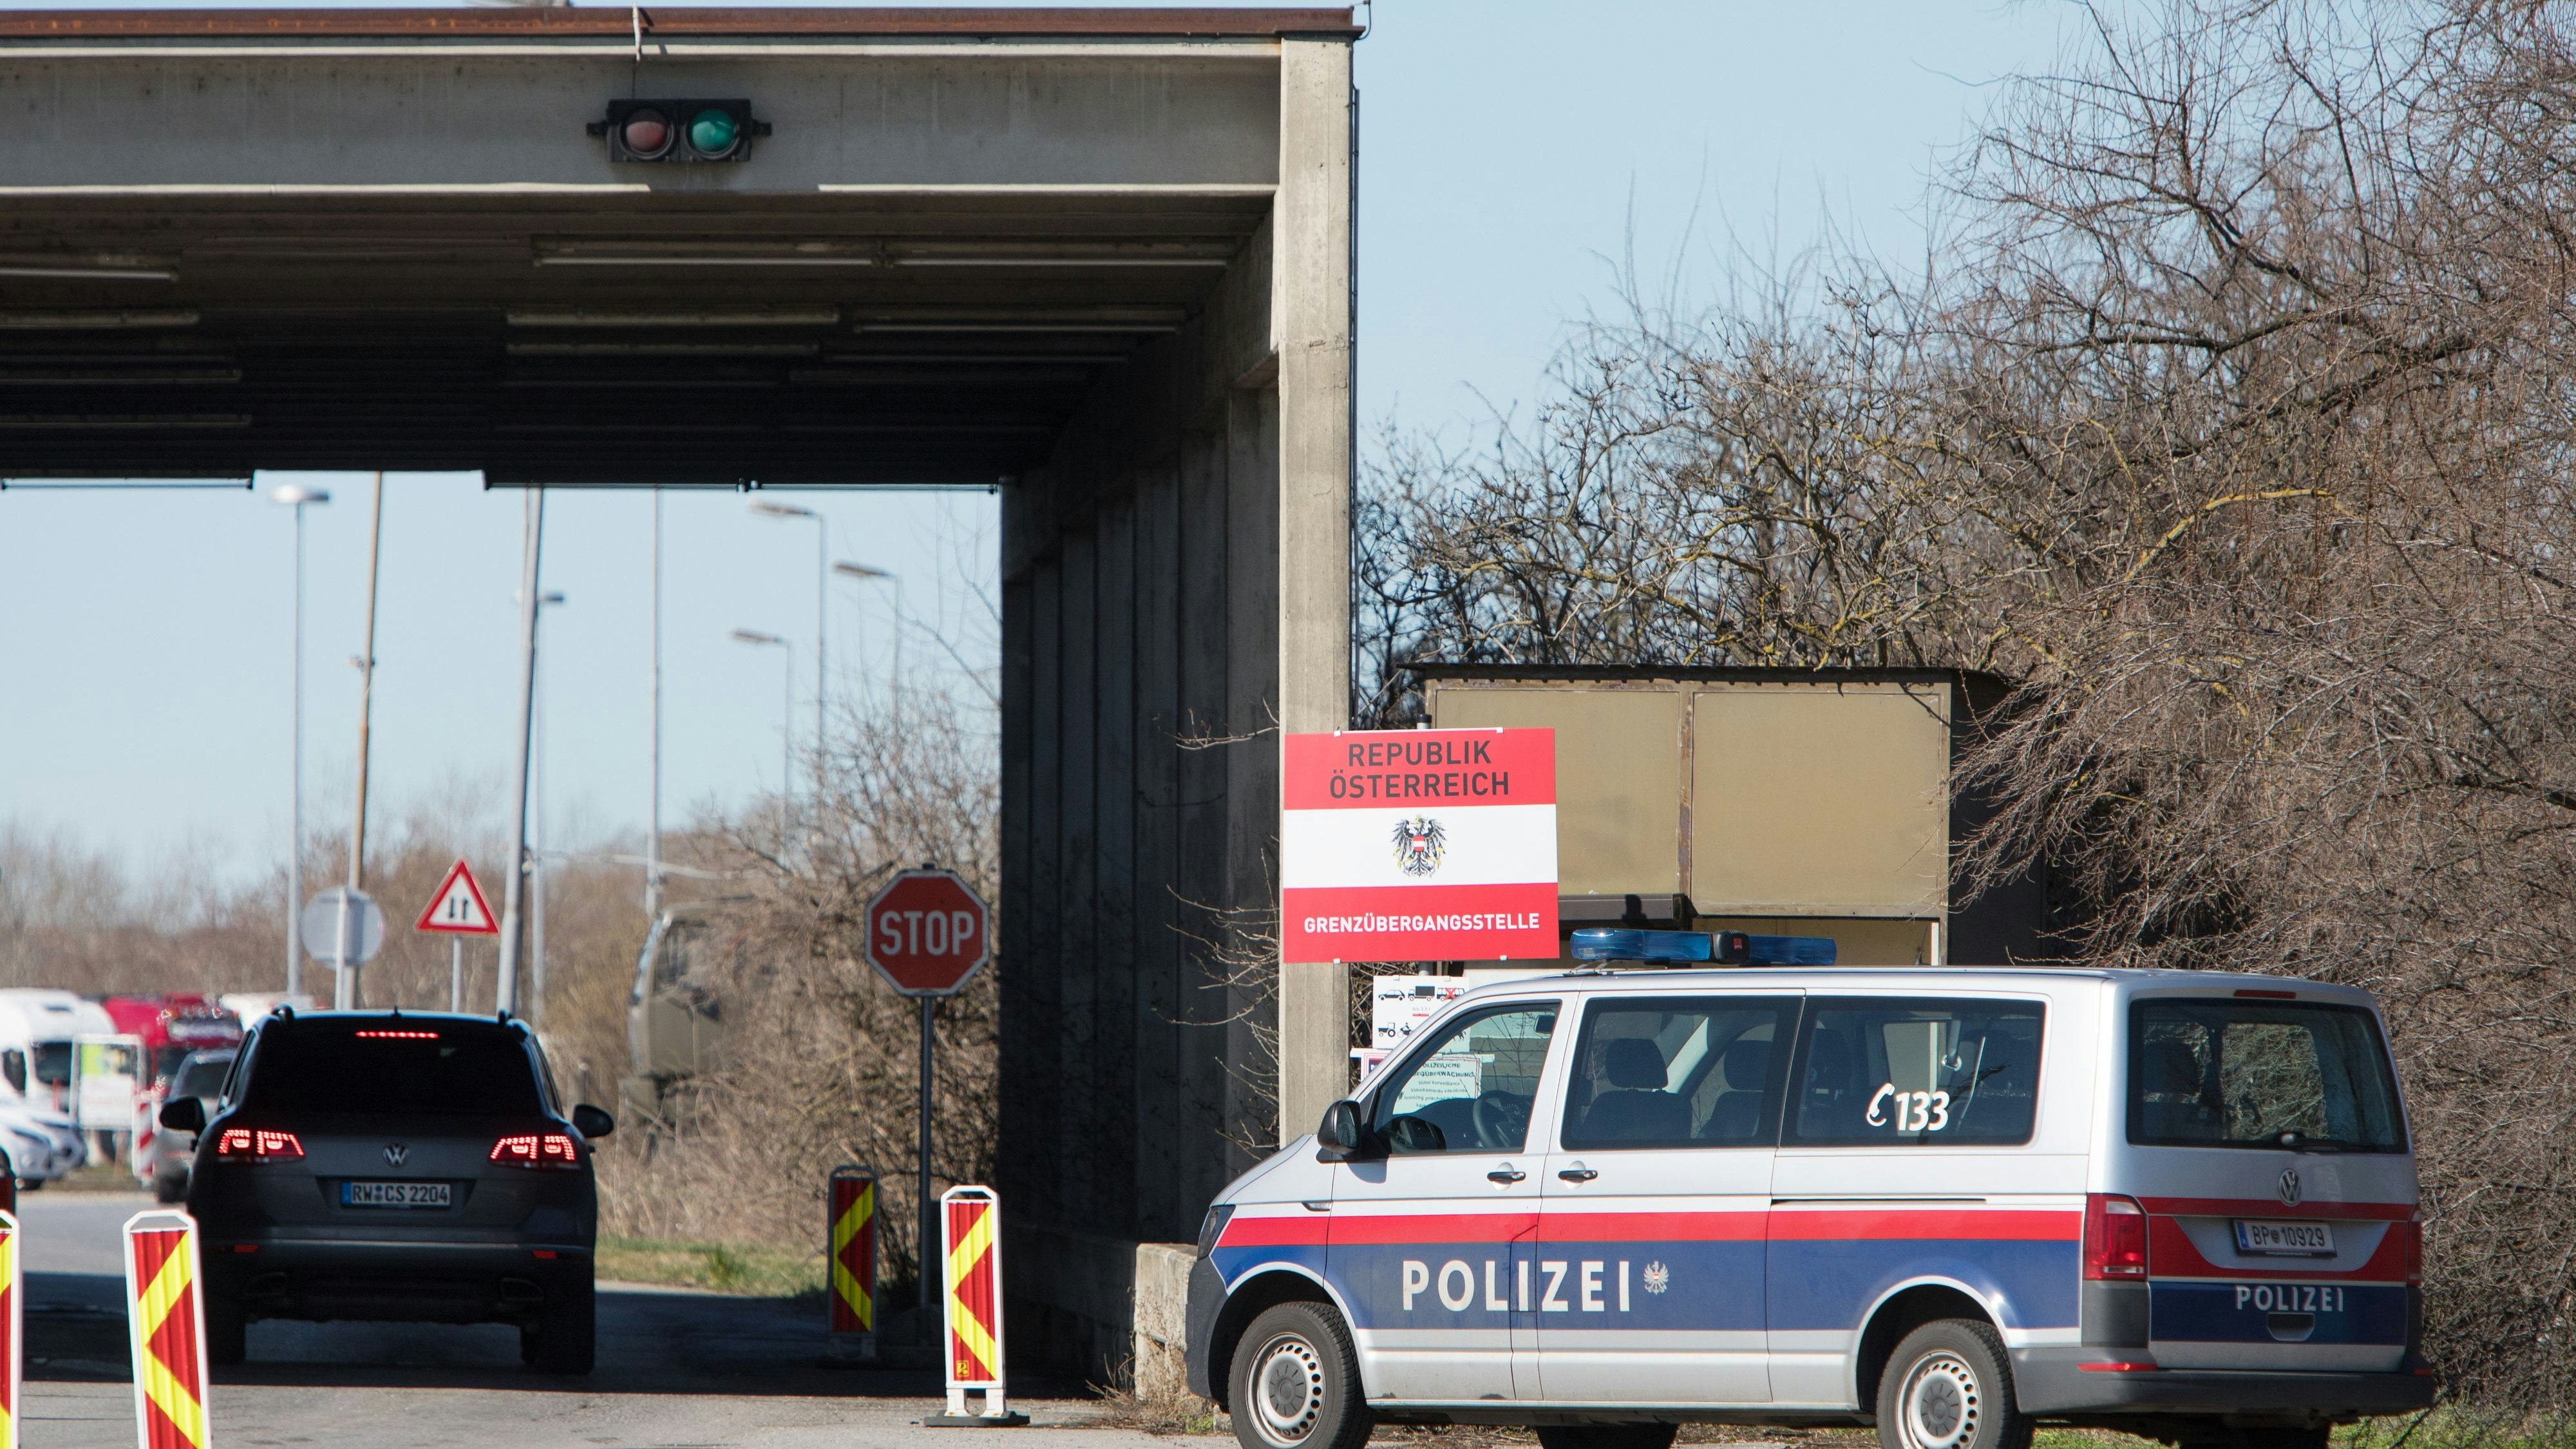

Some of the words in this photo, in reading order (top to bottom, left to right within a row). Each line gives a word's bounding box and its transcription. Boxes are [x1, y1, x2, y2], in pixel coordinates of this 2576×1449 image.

[1349, 740, 1492, 766] REPUBLIK
[1330, 769, 1509, 799] ÖSTERREICH
[880, 910, 974, 956] STOP
[1304, 913, 1540, 933] GRENZÜBERGANGSSTELLE
[1895, 1090, 1950, 1131] 133
[410, 1186, 448, 1202] 2204
[2252, 1226, 2269, 1245] BP
[2281, 1226, 2325, 1247] 10929
[1403, 1260, 1630, 1312] POLIZEI
[2236, 1285, 2344, 1312] POLIZEI
